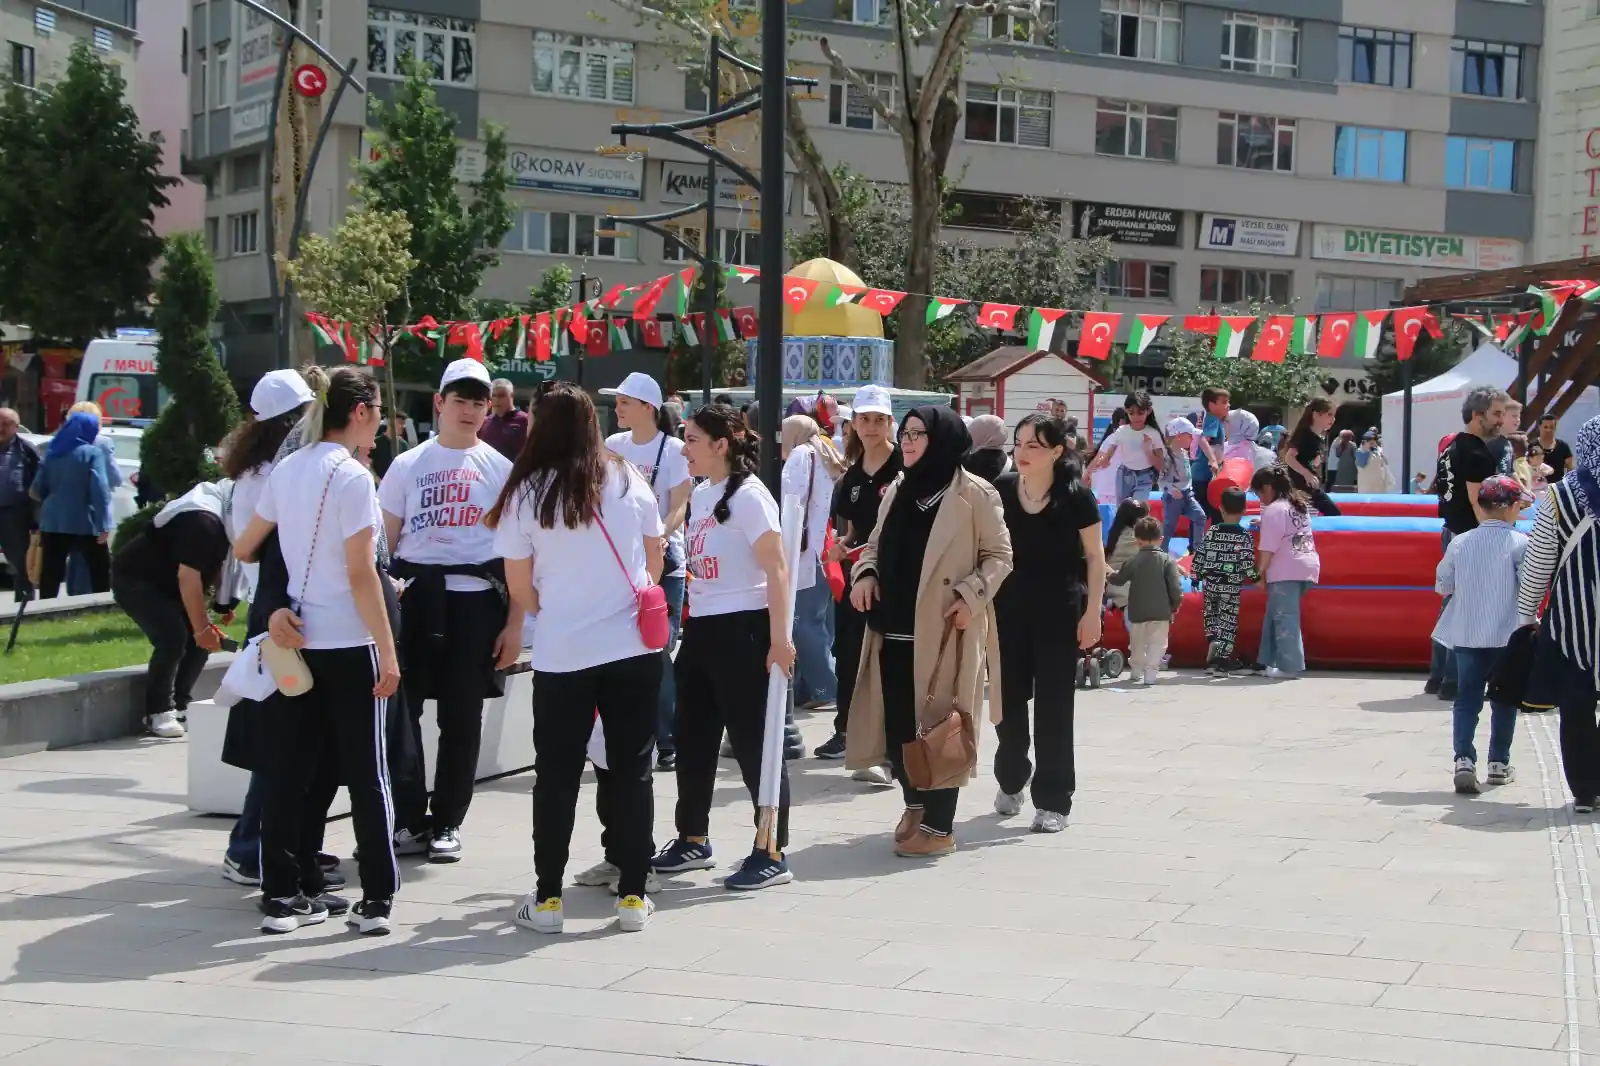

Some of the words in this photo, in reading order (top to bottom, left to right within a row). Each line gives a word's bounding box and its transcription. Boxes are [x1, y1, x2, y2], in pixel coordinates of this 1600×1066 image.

[528, 157, 585, 177] KORAY
[1104, 206, 1136, 219] ERDEM
[1138, 209, 1172, 222] HUKUK
[111, 397, 143, 416] 112
[420, 482, 471, 509] GÜCÜ
